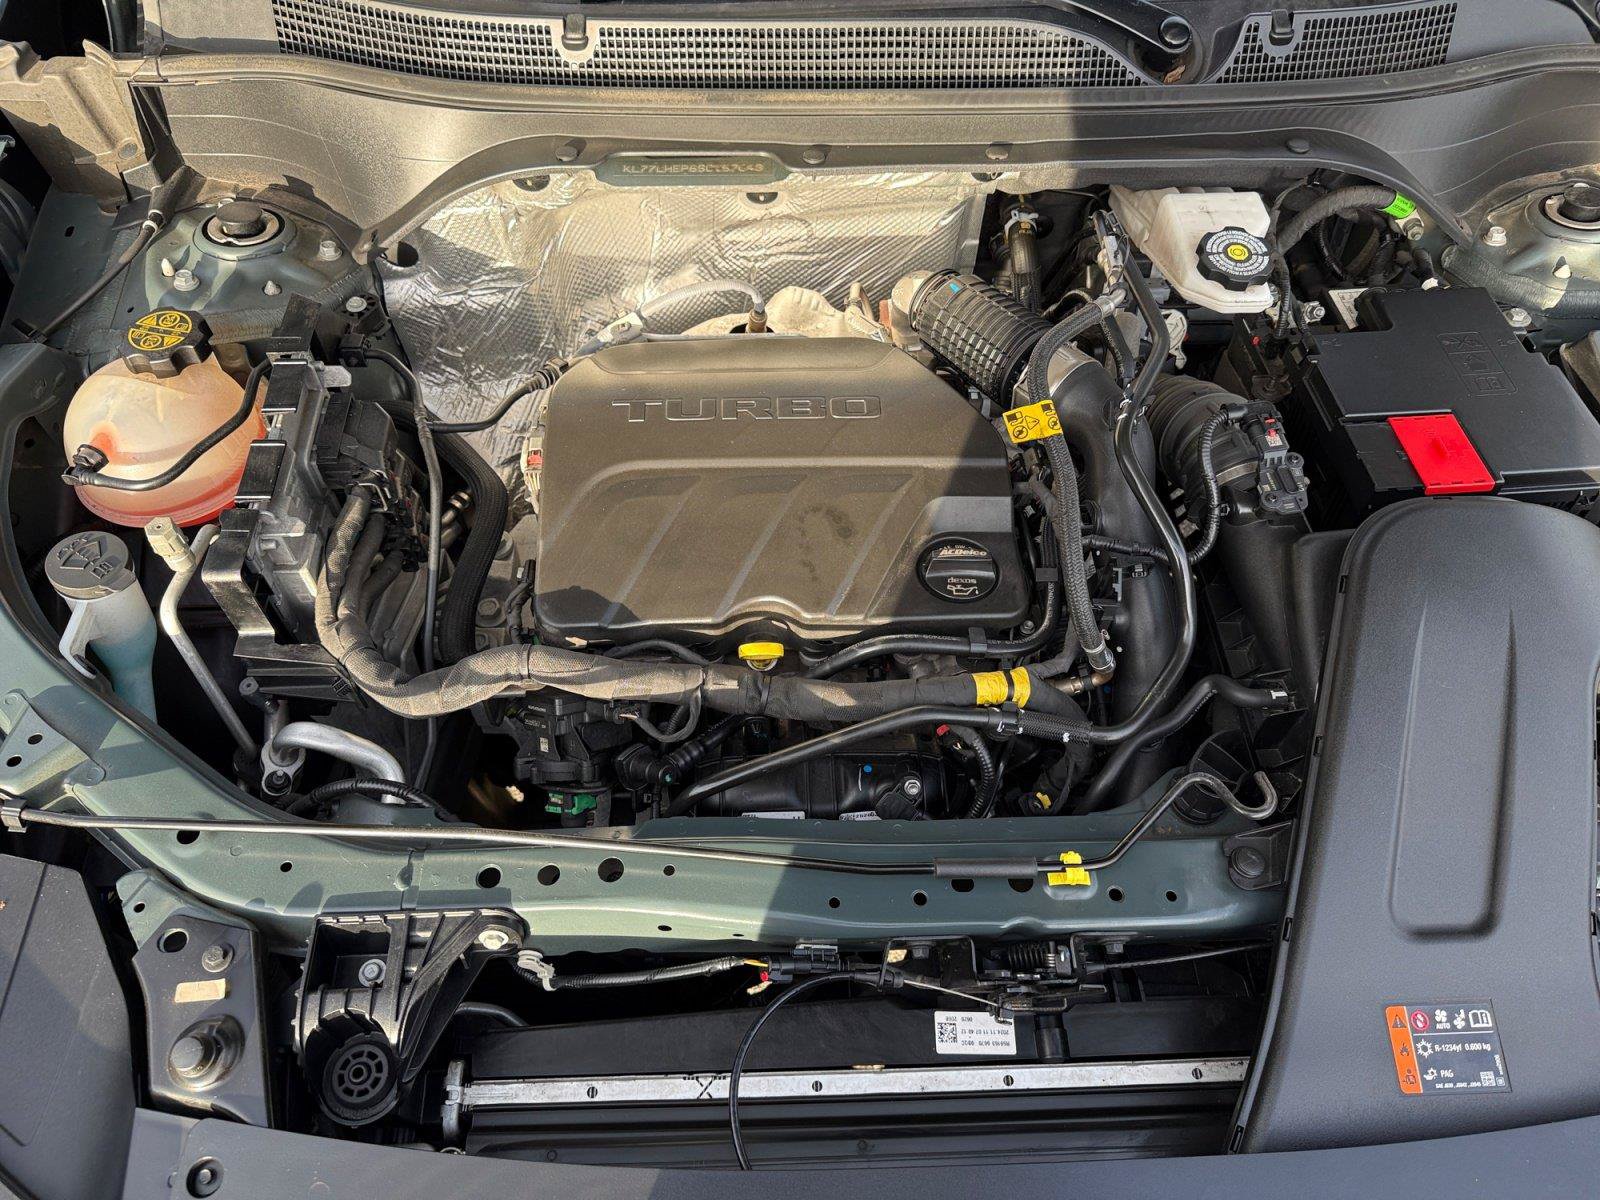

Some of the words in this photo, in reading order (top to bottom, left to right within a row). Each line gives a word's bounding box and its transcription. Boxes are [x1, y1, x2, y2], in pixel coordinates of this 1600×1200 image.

[611, 396, 881, 423] TURBO
[939, 548, 987, 556] ACDelco
[1436, 1022, 1450, 1030] AUTO
[1434, 1043, 1462, 1053] R-1234yf
[1439, 1069, 1454, 1078] PAG
